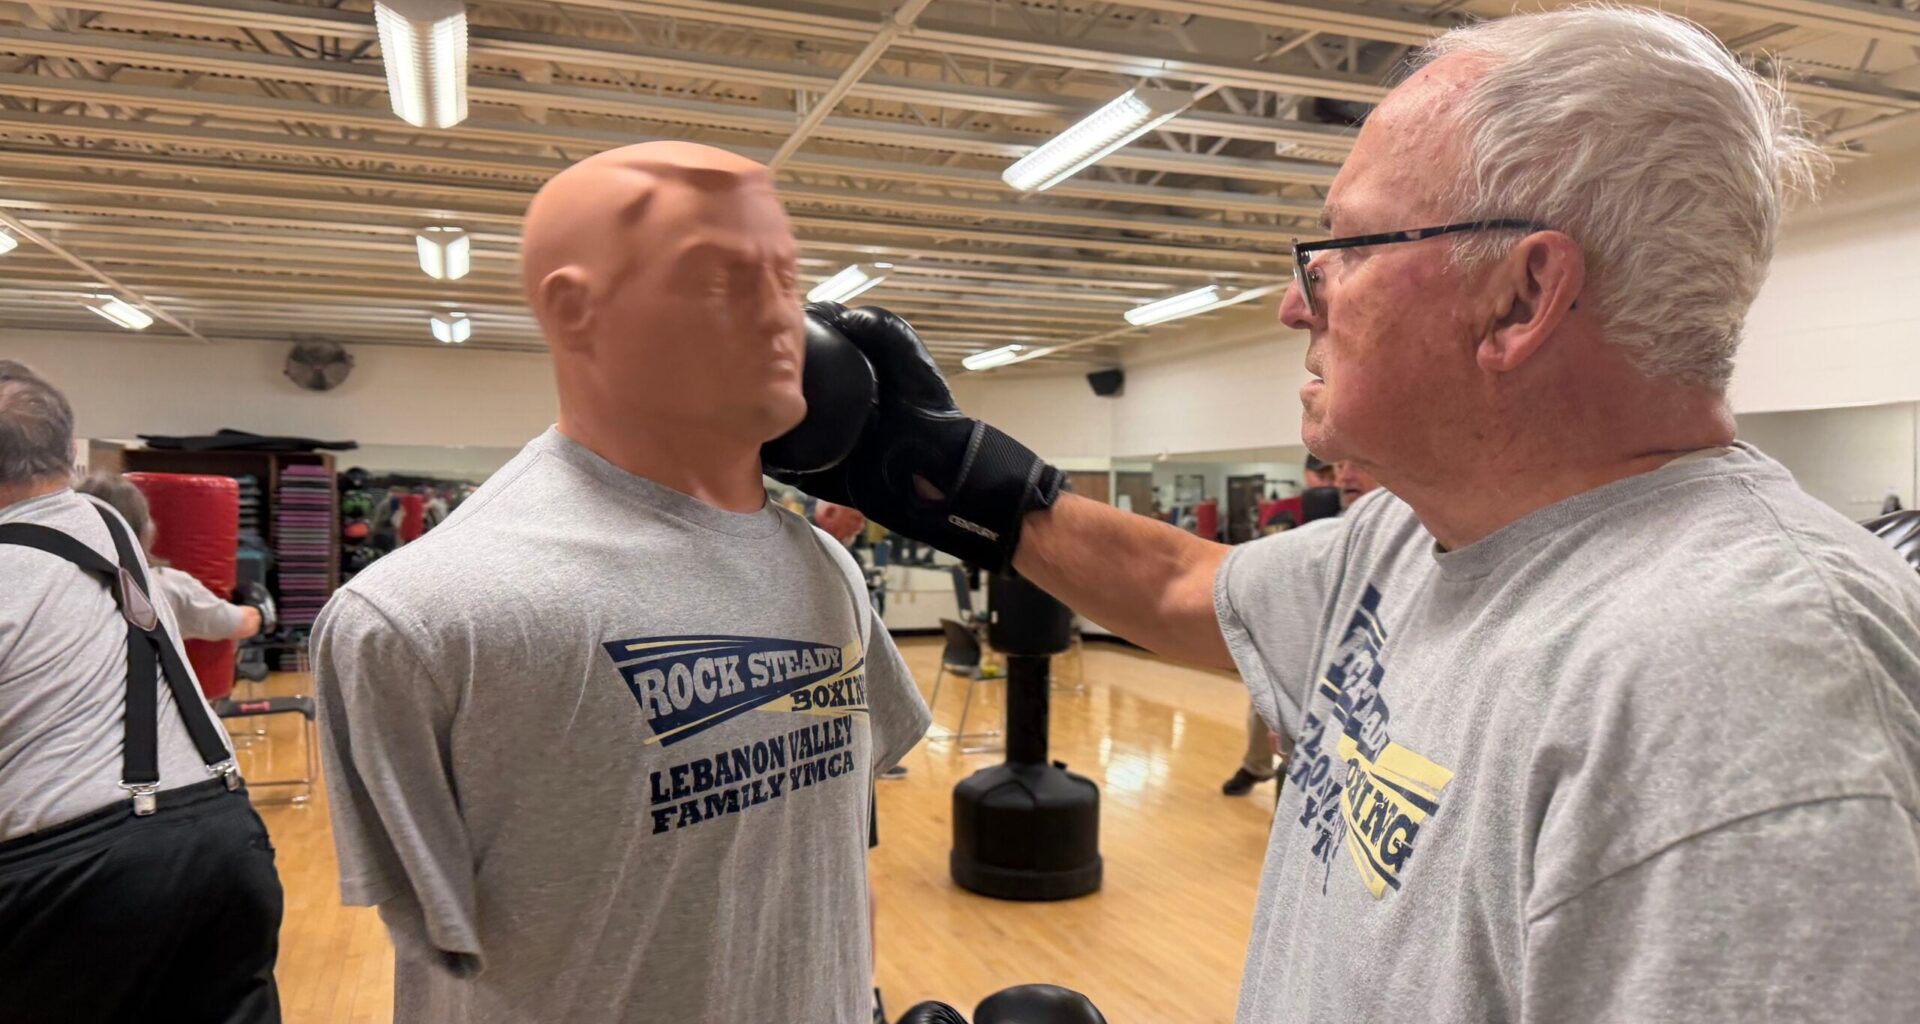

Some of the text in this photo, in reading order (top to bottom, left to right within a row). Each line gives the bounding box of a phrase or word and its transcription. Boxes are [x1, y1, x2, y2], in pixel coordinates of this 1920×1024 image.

[633, 648, 840, 720] ROCK STEADY
[789, 673, 865, 712] BOXIN
[650, 714, 852, 805] LEBANON VALLEY
[651, 751, 855, 835] FAMILY YMCA
[1345, 757, 1420, 874] OXING
